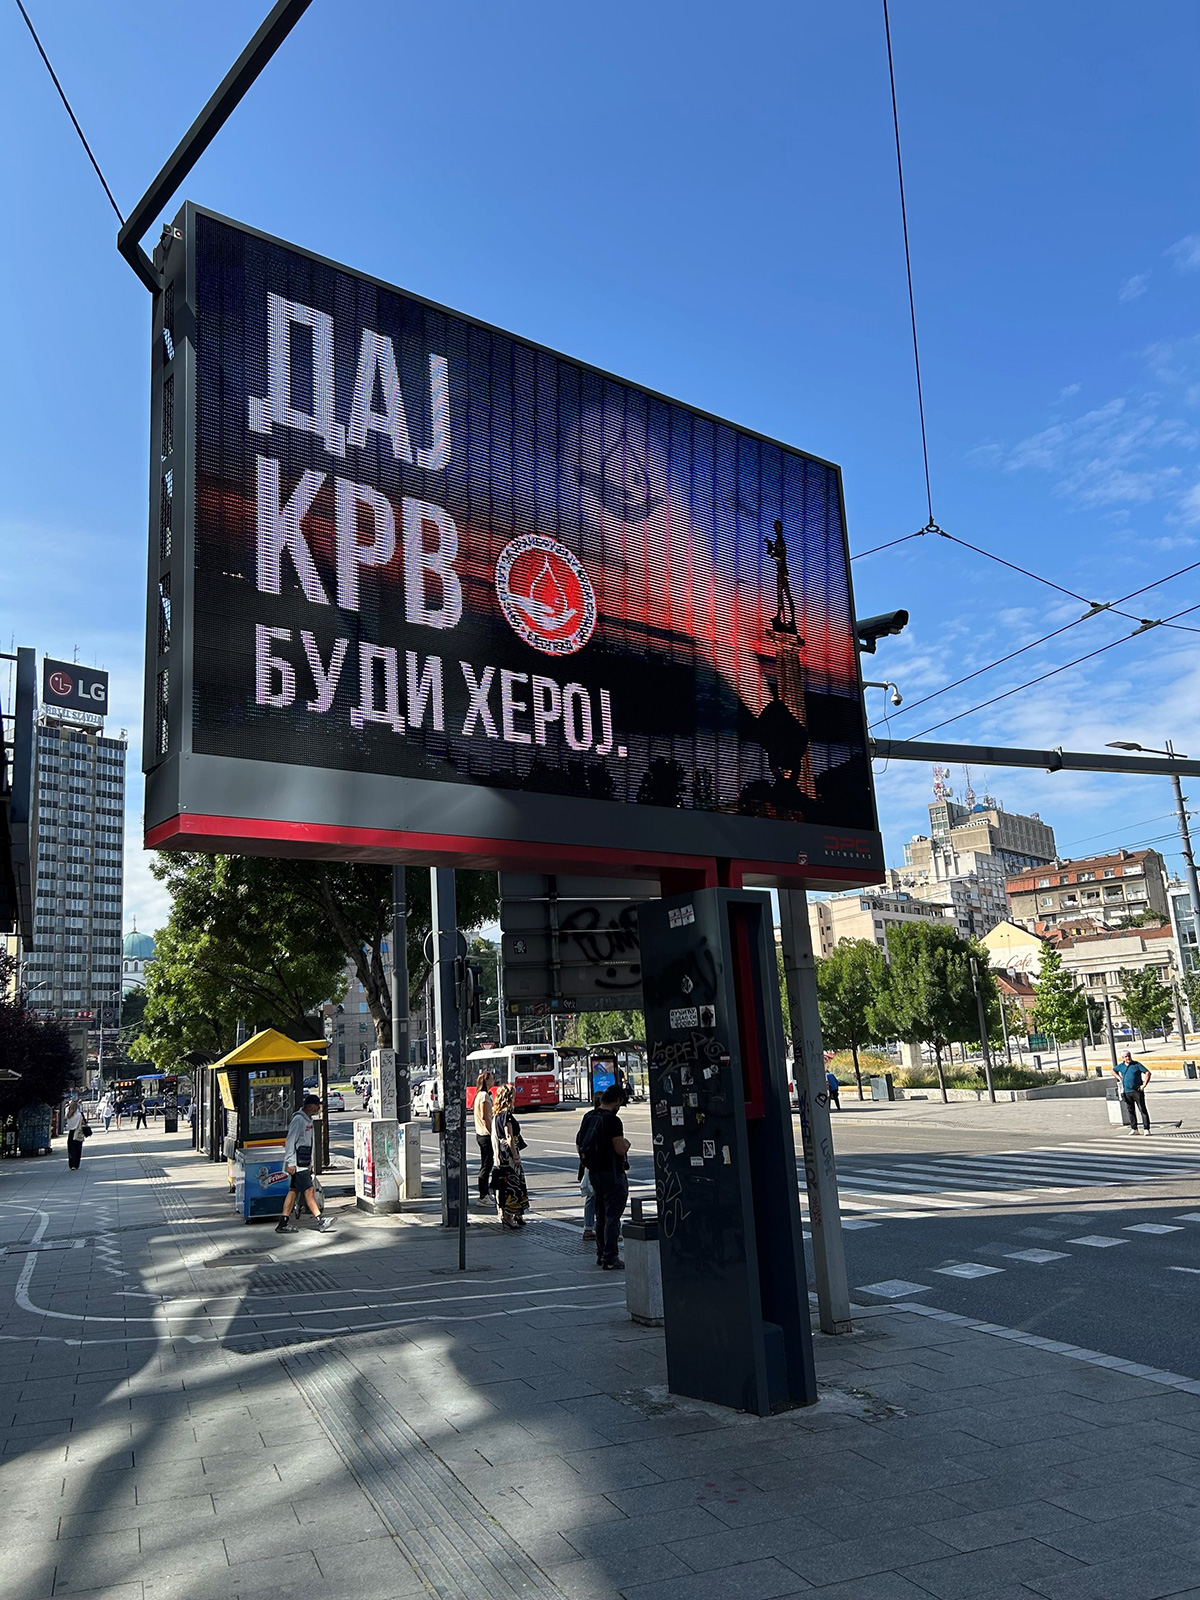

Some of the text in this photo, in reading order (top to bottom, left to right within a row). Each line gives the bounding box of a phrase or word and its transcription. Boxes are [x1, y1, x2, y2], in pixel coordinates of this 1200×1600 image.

[248, 291, 449, 471] ДАЈ
[255, 453, 463, 630] КРВ
[78, 679, 105, 701] LG
[254, 623, 628, 758] БУДИ ХЕРОЈ.
